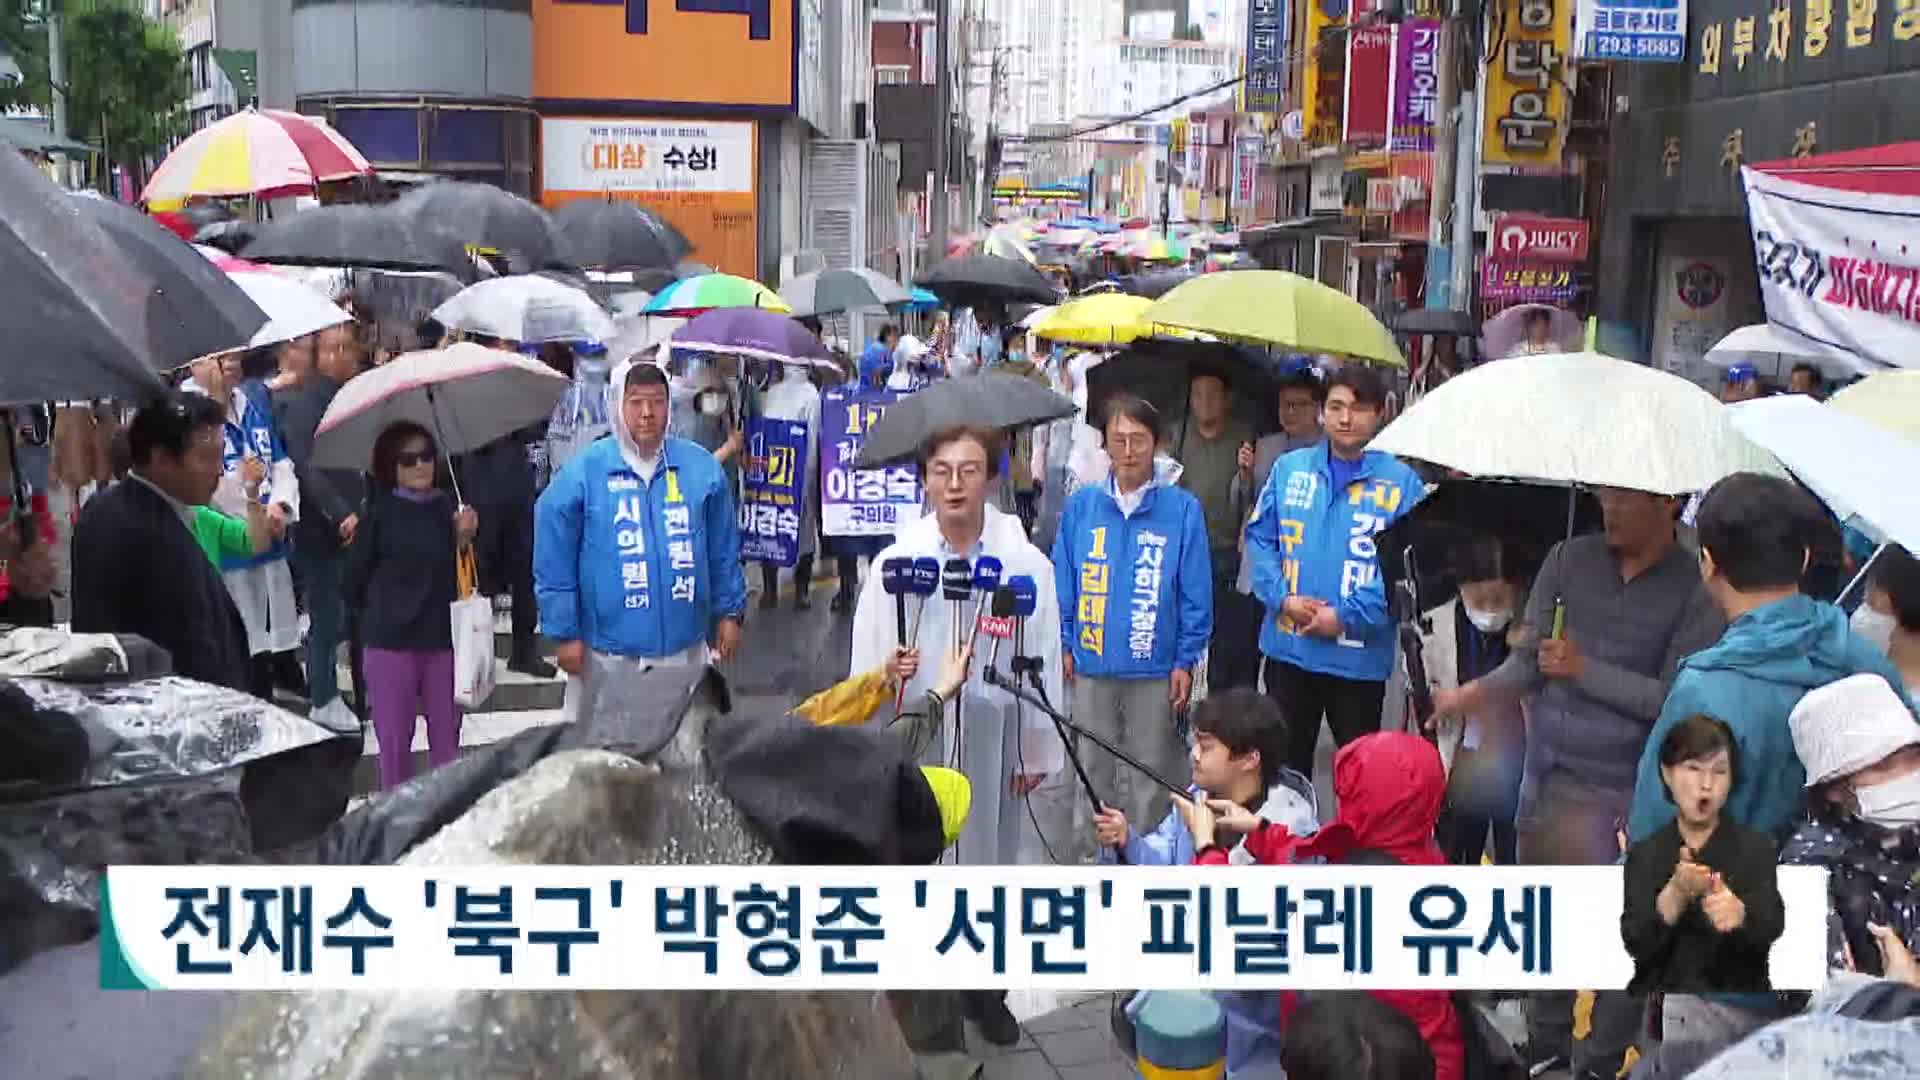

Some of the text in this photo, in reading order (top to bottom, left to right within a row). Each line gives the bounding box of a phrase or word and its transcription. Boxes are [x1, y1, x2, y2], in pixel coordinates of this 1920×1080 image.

[593, 143, 717, 171] 대상 수상!
[1528, 230, 1580, 252] JUICY
[663, 470, 685, 504] 1
[613, 495, 649, 591] 시의원
[1087, 526, 1108, 560] 1
